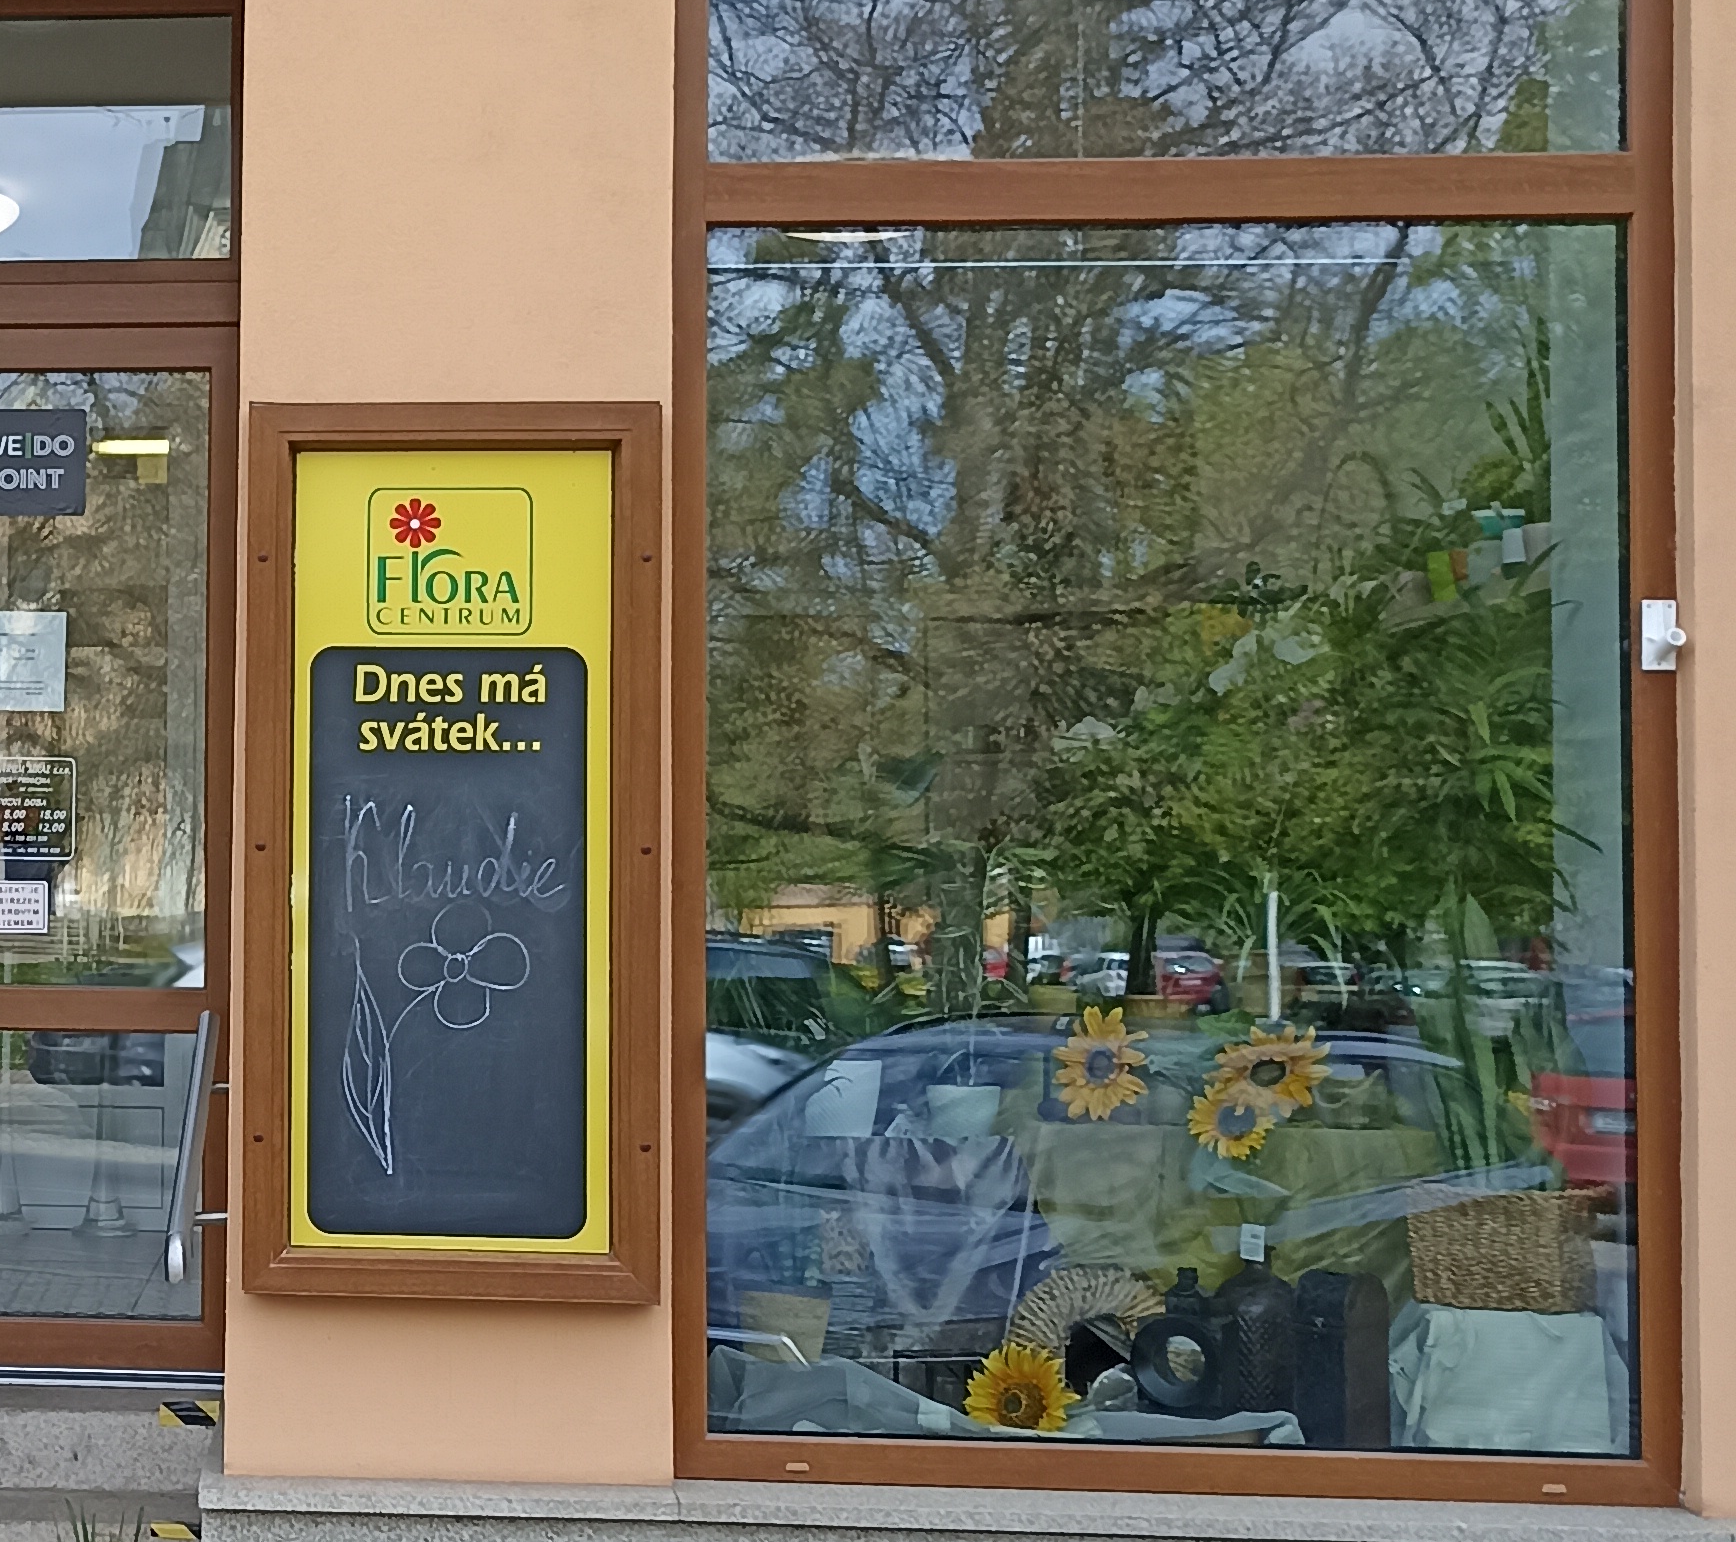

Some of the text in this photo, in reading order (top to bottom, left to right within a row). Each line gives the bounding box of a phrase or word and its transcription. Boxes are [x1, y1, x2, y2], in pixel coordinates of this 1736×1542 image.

[376, 607, 521, 626] CENTRUM
[354, 663, 547, 703] Dnes má
[358, 711, 542, 752] svátek...
